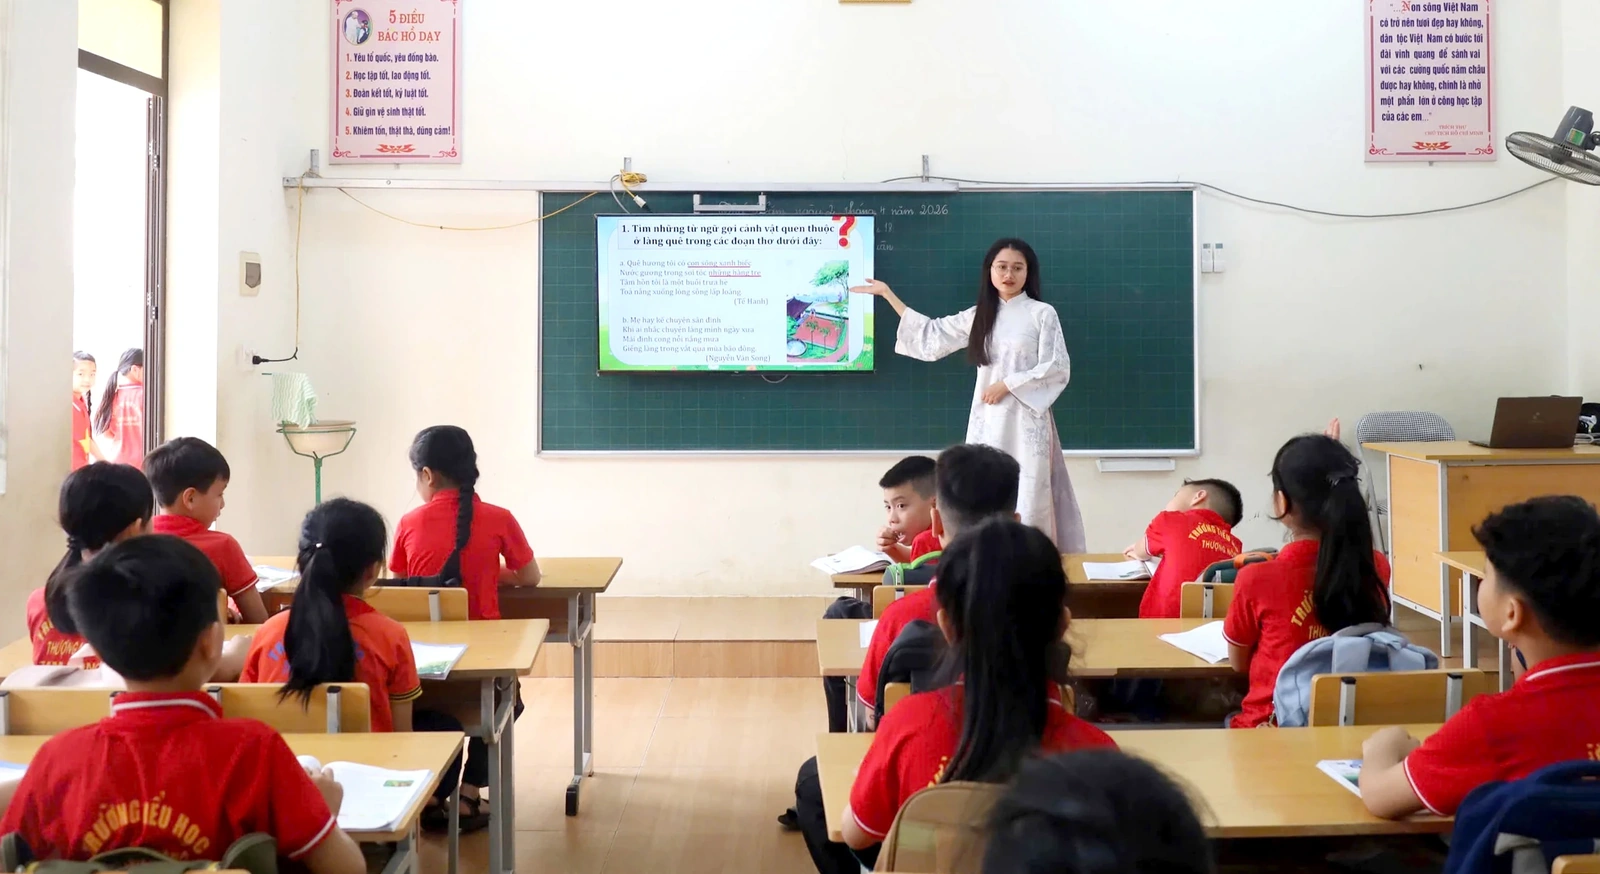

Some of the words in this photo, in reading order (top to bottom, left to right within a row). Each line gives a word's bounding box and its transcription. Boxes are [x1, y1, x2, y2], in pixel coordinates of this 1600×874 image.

[1423, 2, 1441, 13] sông
[1444, 1, 1458, 14] Việt
[1461, 2, 1478, 12] Nam
[388, 9, 397, 24] 5
[398, 8, 425, 25] ĐIỀU
[1379, 17, 1389, 28] có
[1390, 16, 1400, 28] trở
[1401, 17, 1415, 28] nên
[1416, 17, 1430, 28] tươi
[1431, 17, 1445, 30] đẹp
[1446, 17, 1459, 29] hay
[1460, 17, 1484, 29] không,
[377, 27, 399, 42] BÁC
[400, 25, 416, 42] HỒ
[419, 31, 441, 44] DẠY
[1379, 33, 1393, 44] dân
[1396, 33, 1408, 46] tộc
[1409, 33, 1423, 46] Việt
[1426, 33, 1443, 43] Nam
[1444, 33, 1454, 43] có
[1454, 32, 1473, 43] bước
[1473, 32, 1484, 43] tới
[345, 52, 352, 63] 1.
[354, 52, 366, 63] Yêu
[367, 51, 374, 63] tổ
[375, 51, 393, 63] quốc,
[394, 52, 406, 64] yêu
[407, 51, 423, 64] đồng
[424, 52, 440, 63] bào.
[1380, 49, 1392, 59] đài
[1394, 49, 1410, 59] vinh
[1413, 50, 1435, 61] quang
[1438, 46, 1448, 59] để
[1451, 48, 1468, 59] sánh
[1469, 48, 1481, 59] vai
[345, 70, 352, 80] 2.
[353, 70, 366, 83] Học
[367, 70, 378, 83] tập
[379, 69, 390, 81] tốt,
[391, 70, 402, 80] lao
[403, 70, 419, 82] động
[420, 69, 431, 80] tốt.
[1380, 64, 1391, 75] với
[1392, 64, 1406, 75] các
[1409, 63, 1431, 76] cường
[1432, 62, 1450, 76] quốc
[1451, 64, 1467, 75] năm
[1468, 64, 1486, 75] châu
[1380, 80, 1398, 93] được
[1399, 80, 1412, 91] hay
[1413, 79, 1437, 92] không,
[1438, 79, 1458, 90] chính
[1459, 79, 1467, 90] là
[1468, 78, 1482, 90] nhờ
[345, 88, 352, 98] 3.
[353, 88, 370, 98] Đoàn
[371, 87, 382, 98] kết
[383, 86, 393, 99] tốt,
[395, 87, 403, 99] kỷ
[404, 88, 417, 100] luật
[418, 87, 428, 98] tốt.
[1380, 95, 1394, 108] một
[1397, 93, 1415, 107] phần
[1418, 95, 1430, 106] lớn
[1431, 94, 1436, 106] ở
[1437, 95, 1455, 107] công
[1456, 95, 1470, 108] học
[1471, 95, 1483, 108] tập
[345, 106, 352, 117] 4.
[353, 105, 364, 117] Giữ
[365, 106, 376, 118] gìn
[377, 106, 385, 119] vệ
[386, 107, 400, 117] sinh
[402, 106, 414, 119] thật
[416, 105, 427, 117] tốt.
[1382, 110, 1395, 122] của
[1396, 111, 1409, 122] các
[345, 126, 352, 136] 5.
[353, 125, 374, 136] Khiêm
[375, 124, 388, 136] tốn,
[388, 125, 402, 138] thật
[402, 126, 415, 136] thà,
[416, 125, 433, 137] dũng
[434, 125, 451, 136] cảm!
[880, 205, 886, 215] 4
[891, 206, 915, 215] năm
[920, 204, 949, 215] 2026
[622, 224, 630, 233] 1.
[631, 224, 651, 233] Tìm
[653, 224, 685, 235] những
[687, 224, 698, 233] từ
[700, 224, 719, 235] ngữ
[739, 224, 762, 233] cảnh
[764, 224, 779, 235] vật
[781, 226, 805, 235] quen
[807, 224, 835, 235] thuộc
[633, 237, 641, 245] ở
[643, 236, 664, 248] làng
[665, 236, 684, 247] quê
[685, 238, 712, 247] trong
[713, 236, 729, 245] các
[731, 236, 755, 247] đoạn
[757, 236, 774, 245] thơ
[776, 236, 800, 245] dưới
[802, 236, 822, 247] đây:
[83, 799, 141, 857] RƯỜNG
[172, 813, 210, 855] HỌC
